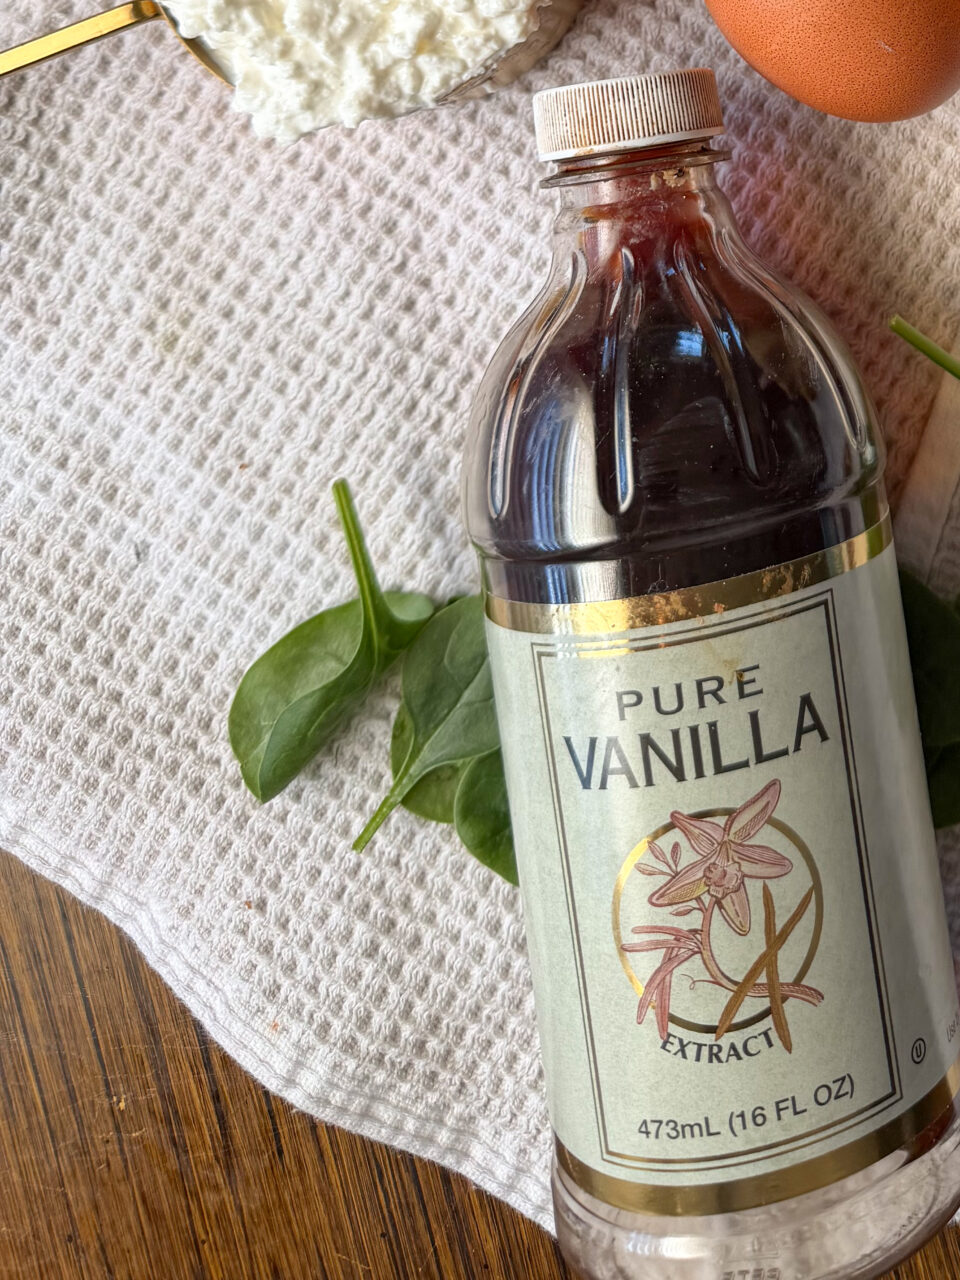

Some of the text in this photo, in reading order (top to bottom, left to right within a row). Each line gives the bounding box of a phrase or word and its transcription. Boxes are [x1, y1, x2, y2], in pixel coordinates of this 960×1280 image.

[616, 664, 764, 720] PURE
[563, 692, 830, 789] VANILLA
[660, 1027, 774, 1063] EXTRACT
[638, 1073, 855, 1139] 473mL (16 FL OZ)
